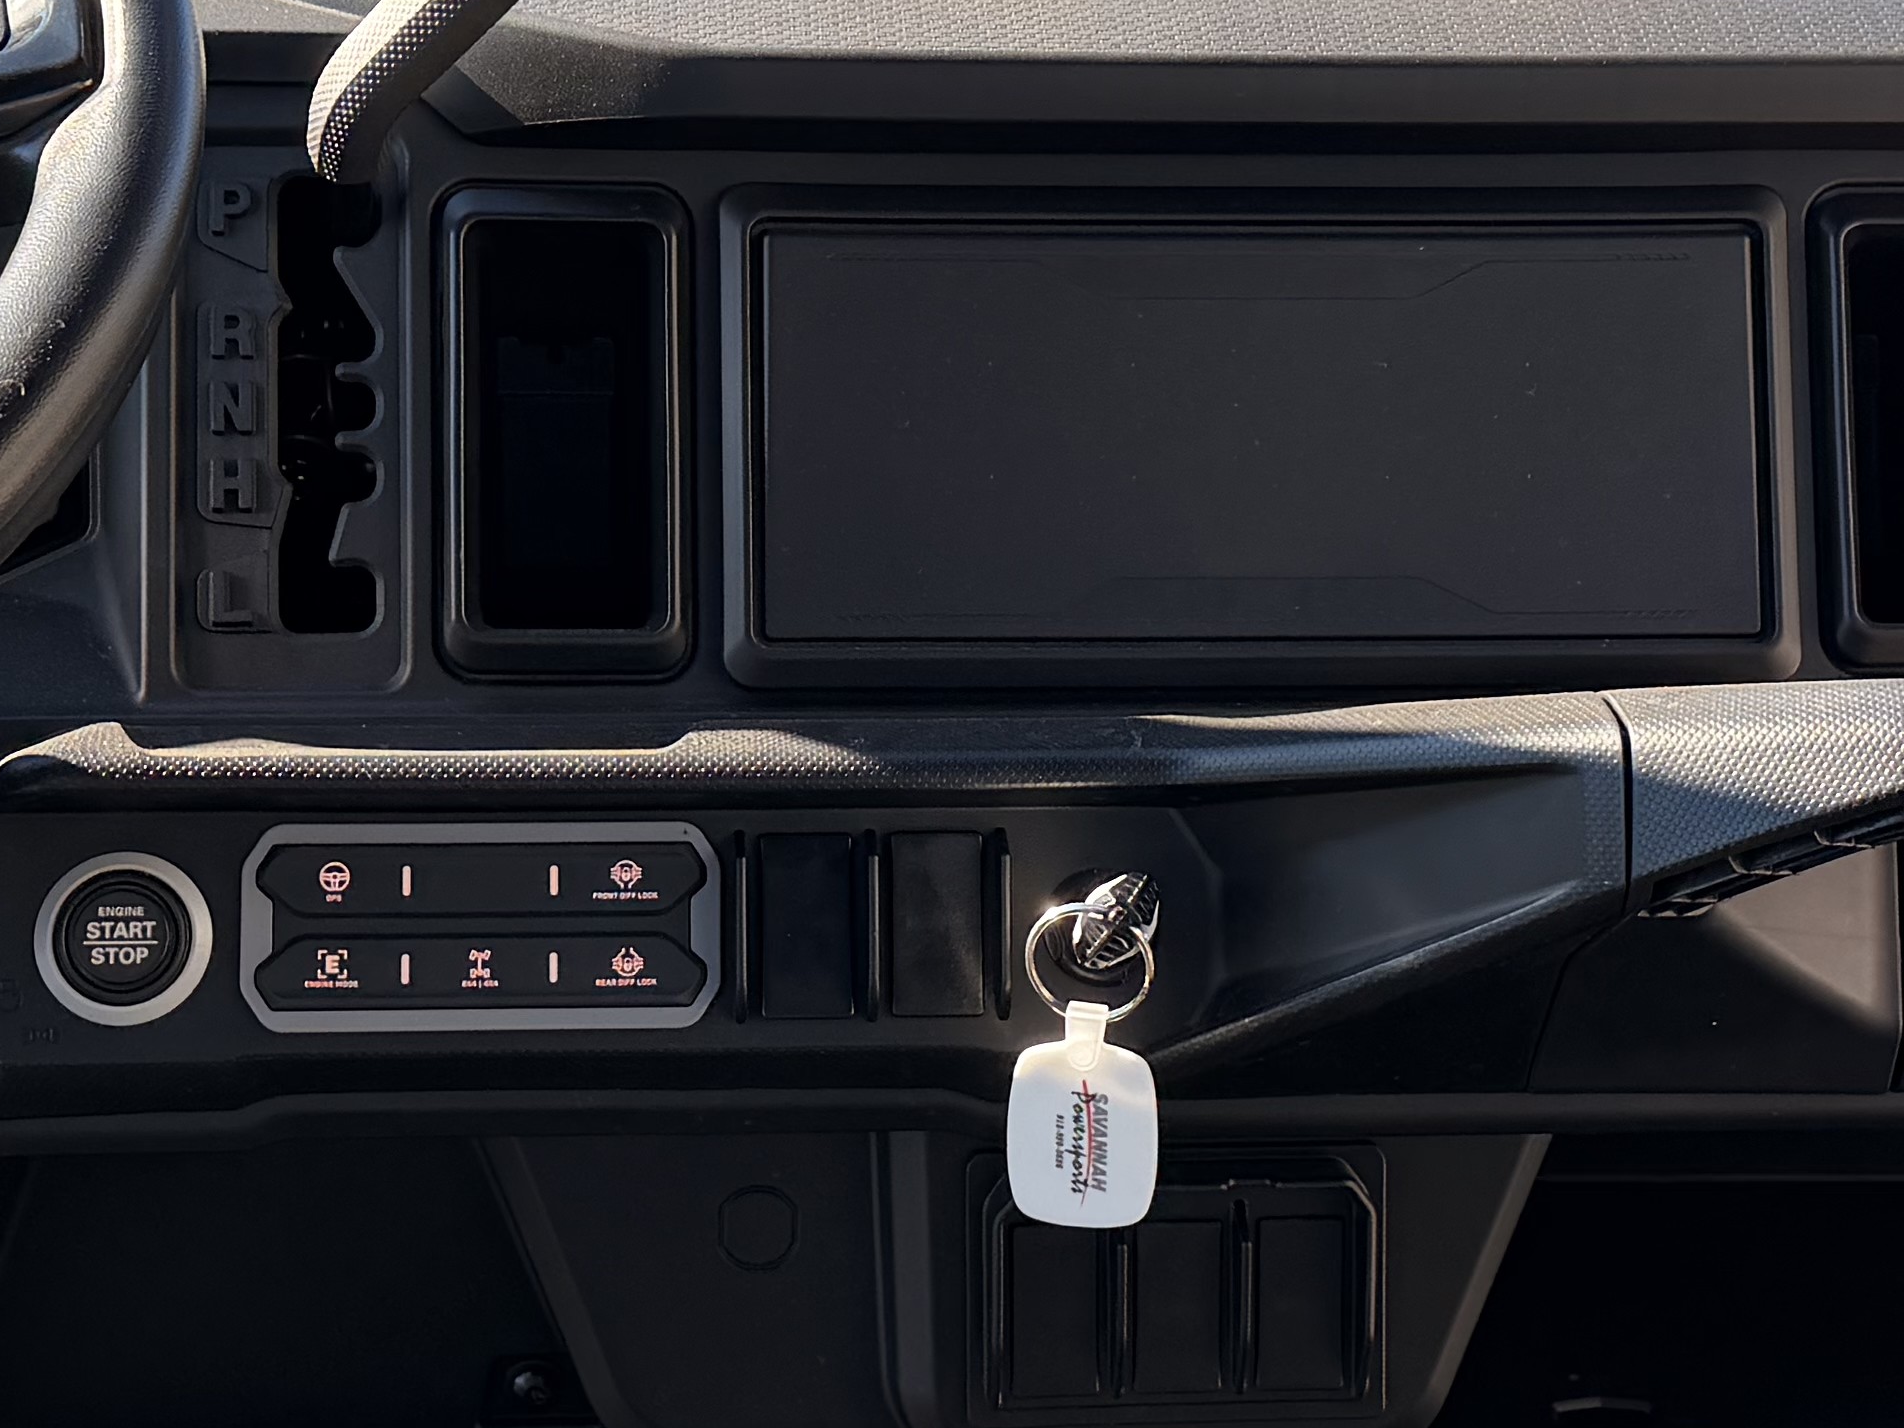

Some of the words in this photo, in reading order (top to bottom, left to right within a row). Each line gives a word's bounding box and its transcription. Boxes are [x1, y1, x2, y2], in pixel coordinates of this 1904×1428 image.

[207, 181, 252, 237] P
[209, 313, 256, 360] R
[208, 380, 256, 437] N
[208, 456, 257, 514] H
[208, 569, 253, 629] L
[637, 891, 659, 900] LOCK
[98, 906, 145, 917] ENGINE
[86, 920, 157, 940] START
[90, 946, 149, 966] STOP
[325, 954, 341, 974] E
[304, 980, 334, 989] ENGINE
[335, 980, 358, 989] MODE
[595, 978, 616, 987] REAR
[635, 978, 657, 987] LOCK
[1092, 1093, 1109, 1193] SAVANNAH
